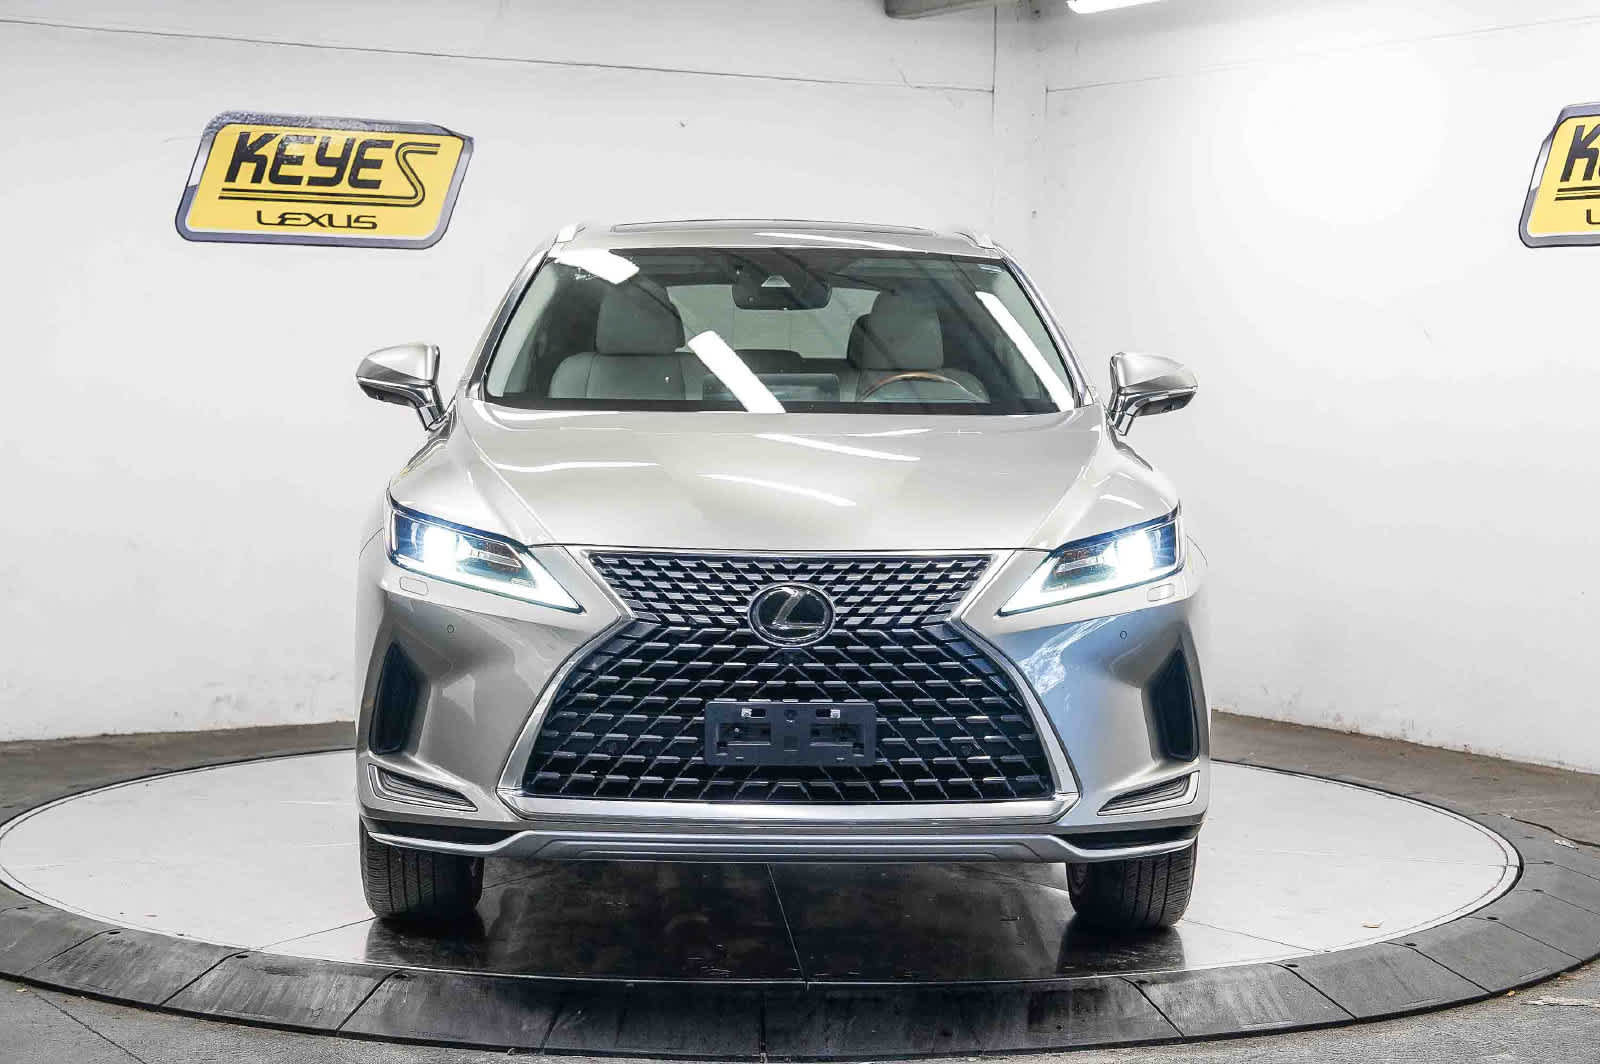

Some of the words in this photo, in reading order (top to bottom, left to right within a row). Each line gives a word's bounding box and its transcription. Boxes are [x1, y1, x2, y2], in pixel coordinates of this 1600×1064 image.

[219, 131, 441, 207] KEYES
[1560, 123, 1600, 182] K
[256, 210, 377, 230] LEXUS
